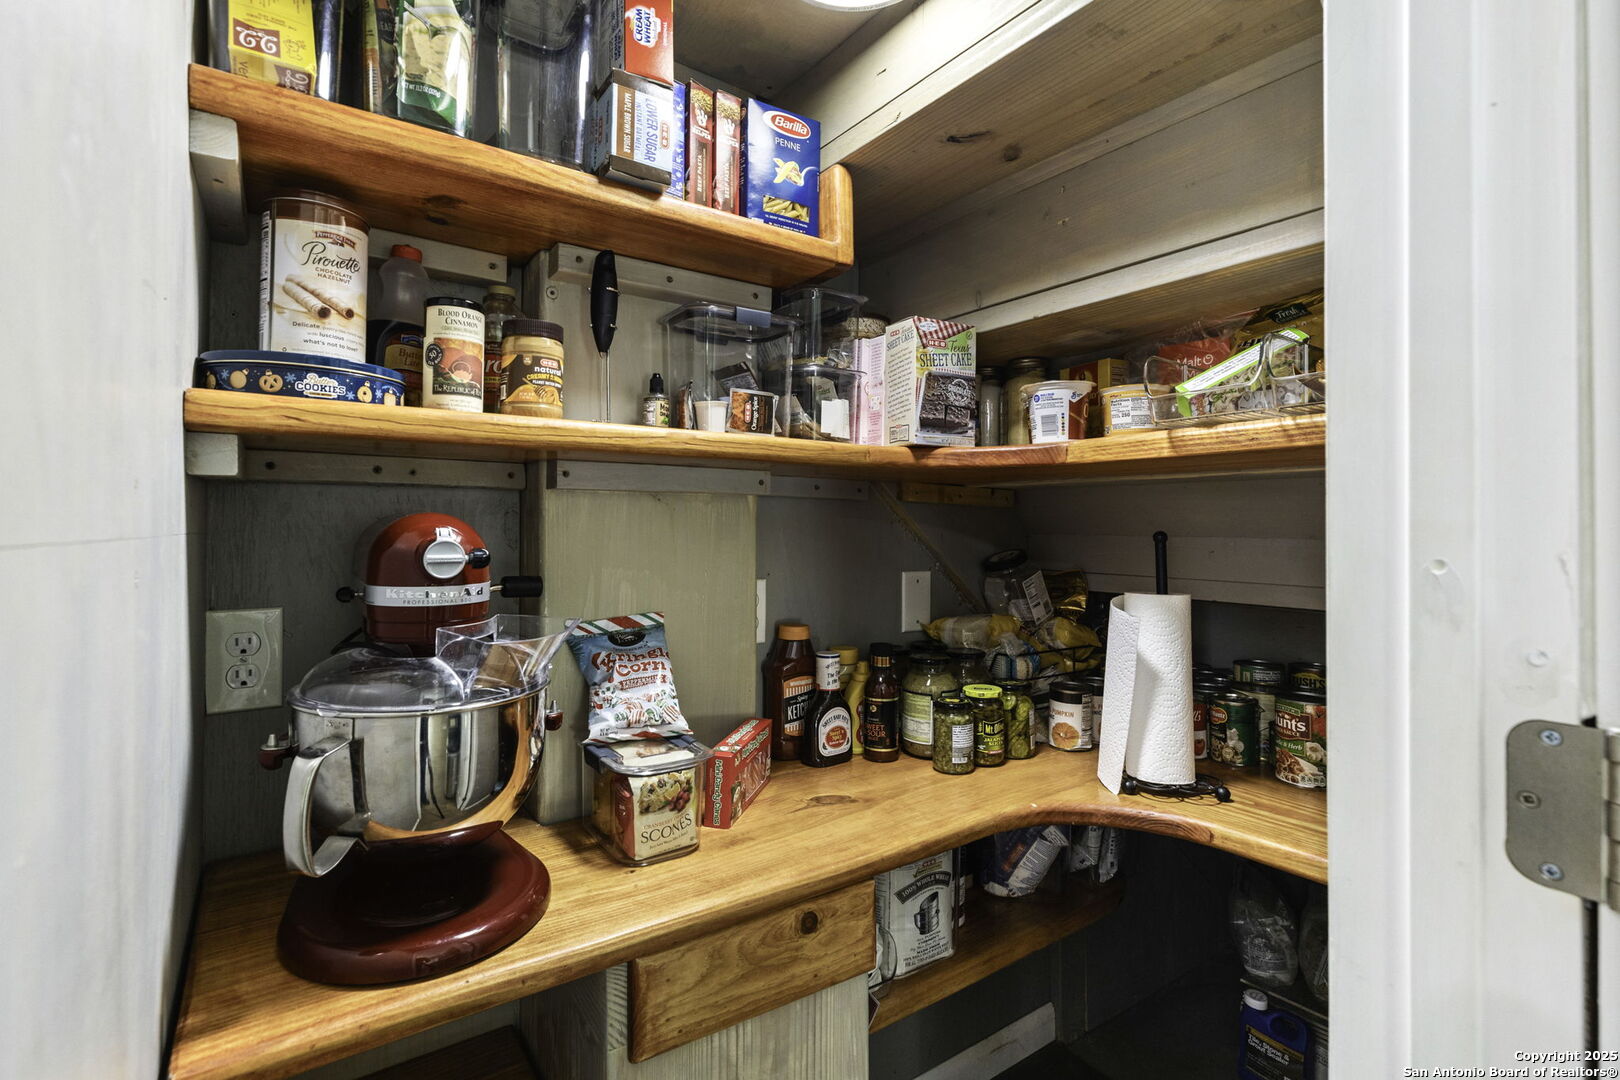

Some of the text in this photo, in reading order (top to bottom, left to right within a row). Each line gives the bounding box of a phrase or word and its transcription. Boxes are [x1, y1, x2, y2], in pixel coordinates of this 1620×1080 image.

[635, 8, 643, 42] CREAM
[643, 10, 652, 44] WHEAT
[643, 98, 659, 163] LOWER SUGAR
[774, 115, 807, 135] Barilla
[775, 137, 801, 152] PENNE
[301, 240, 360, 274] Pirouette
[315, 266, 352, 281] CHOCOLATE
[317, 272, 350, 285] HAZELNUT
[437, 308, 460, 317] BLOOD
[292, 321, 320, 329] Delicate
[445, 317, 479, 329] CINNAMON
[319, 332, 345, 341] luscious
[920, 353, 973, 367] SHEET CAKE
[1176, 357, 1202, 369] Malt
[296, 381, 345, 394] COOKIES
[386, 587, 483, 599] KitchenAid
[616, 661, 667, 677] Corn
[1288, 742, 1303, 750] Herb
[712, 777, 723, 800] Candy
[713, 801, 722, 825] Canes
[640, 813, 692, 843] SCONES
[917, 876, 935, 888] WHOLE
